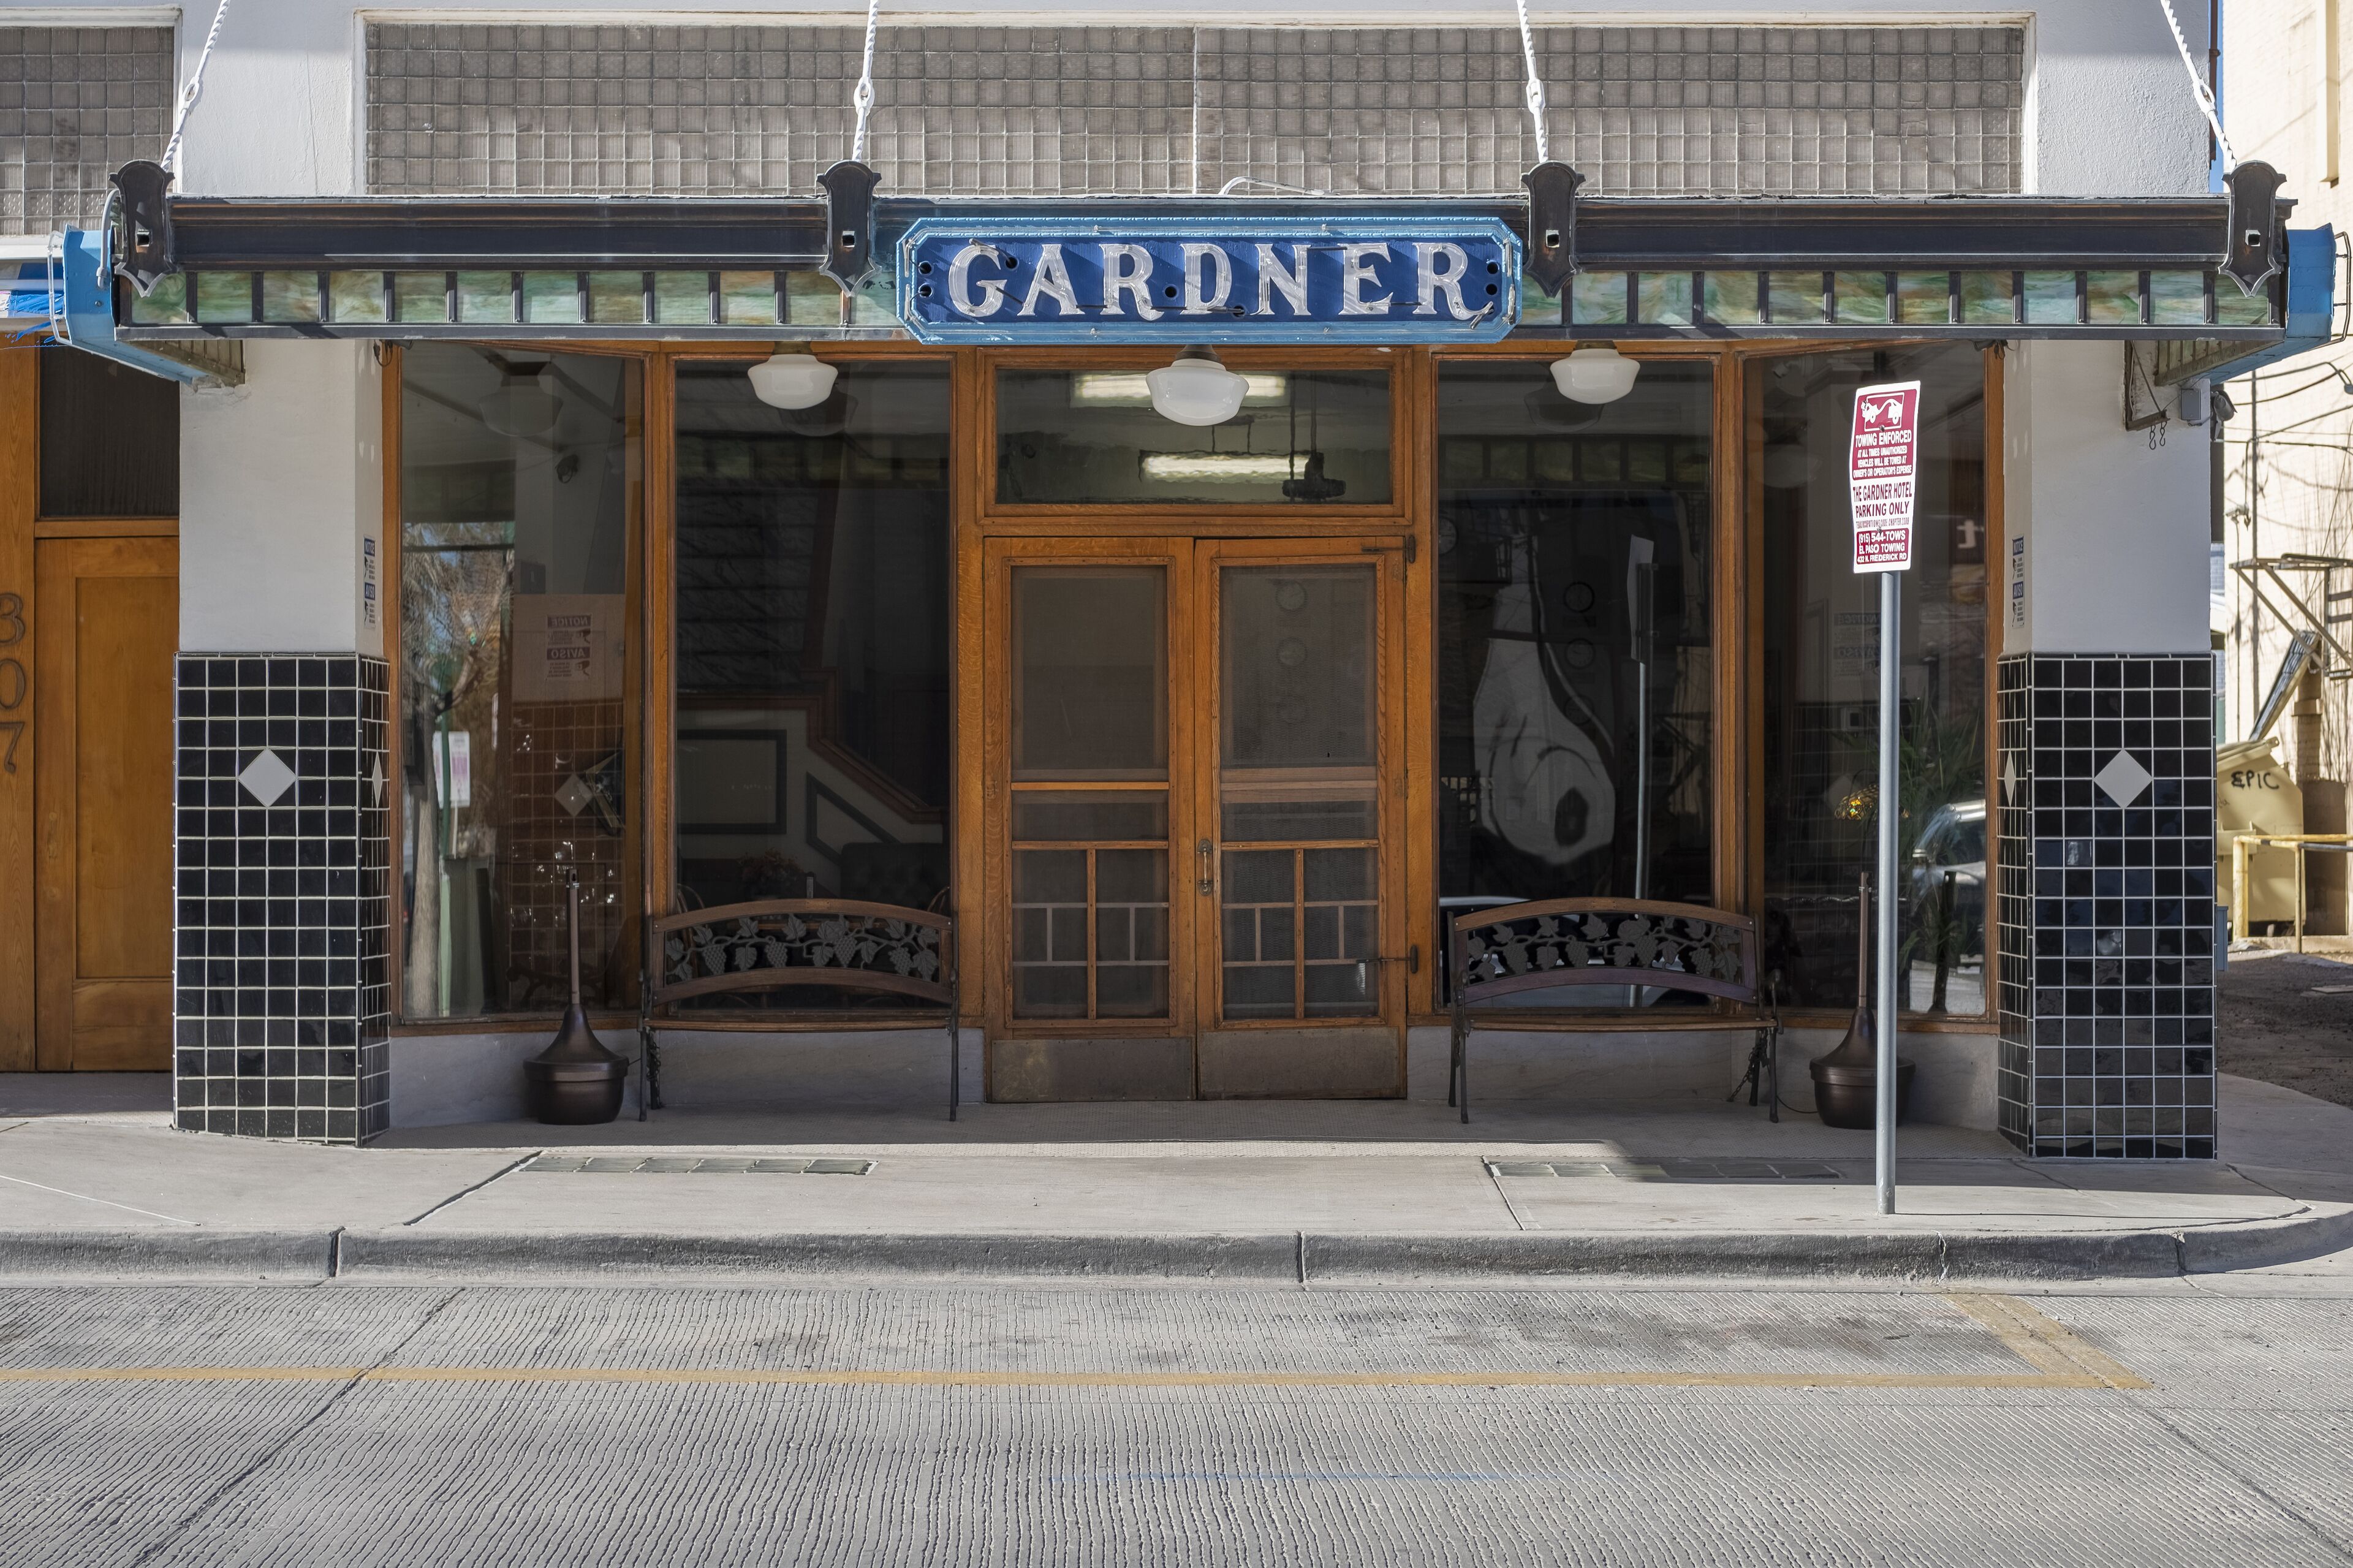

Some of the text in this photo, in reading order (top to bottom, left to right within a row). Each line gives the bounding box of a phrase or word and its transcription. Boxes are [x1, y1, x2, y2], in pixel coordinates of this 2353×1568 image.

[948, 243, 1493, 320] GARDNER
[1855, 430, 1912, 447] TOWING ENFORCED
[1857, 449, 1862, 458] AT
[1868, 448, 1880, 456] TIMES
[1881, 445, 1908, 456] UNAUTHORIZED
[1858, 455, 1907, 468] VEHICLES WILL BE TOWED AT
[1868, 468, 1873, 477] OR
[1896, 464, 1912, 474] EXPENSE
[1853, 482, 1912, 502] THE GARDNER HOTEL
[1856, 501, 1909, 518] PARKING ONLY
[1862, 520, 1880, 528] PATIONS
[1859, 530, 1906, 545] (915) 544-TOWS
[365, 540, 375, 556] NOTICE
[1859, 542, 1905, 554] EL PASO TOWING
[1870, 553, 1898, 562] FREDERICK
[365, 585, 375, 599] AVISO
[2014, 582, 2023, 598] AVISO
[2231, 770, 2279, 790] EPIC
